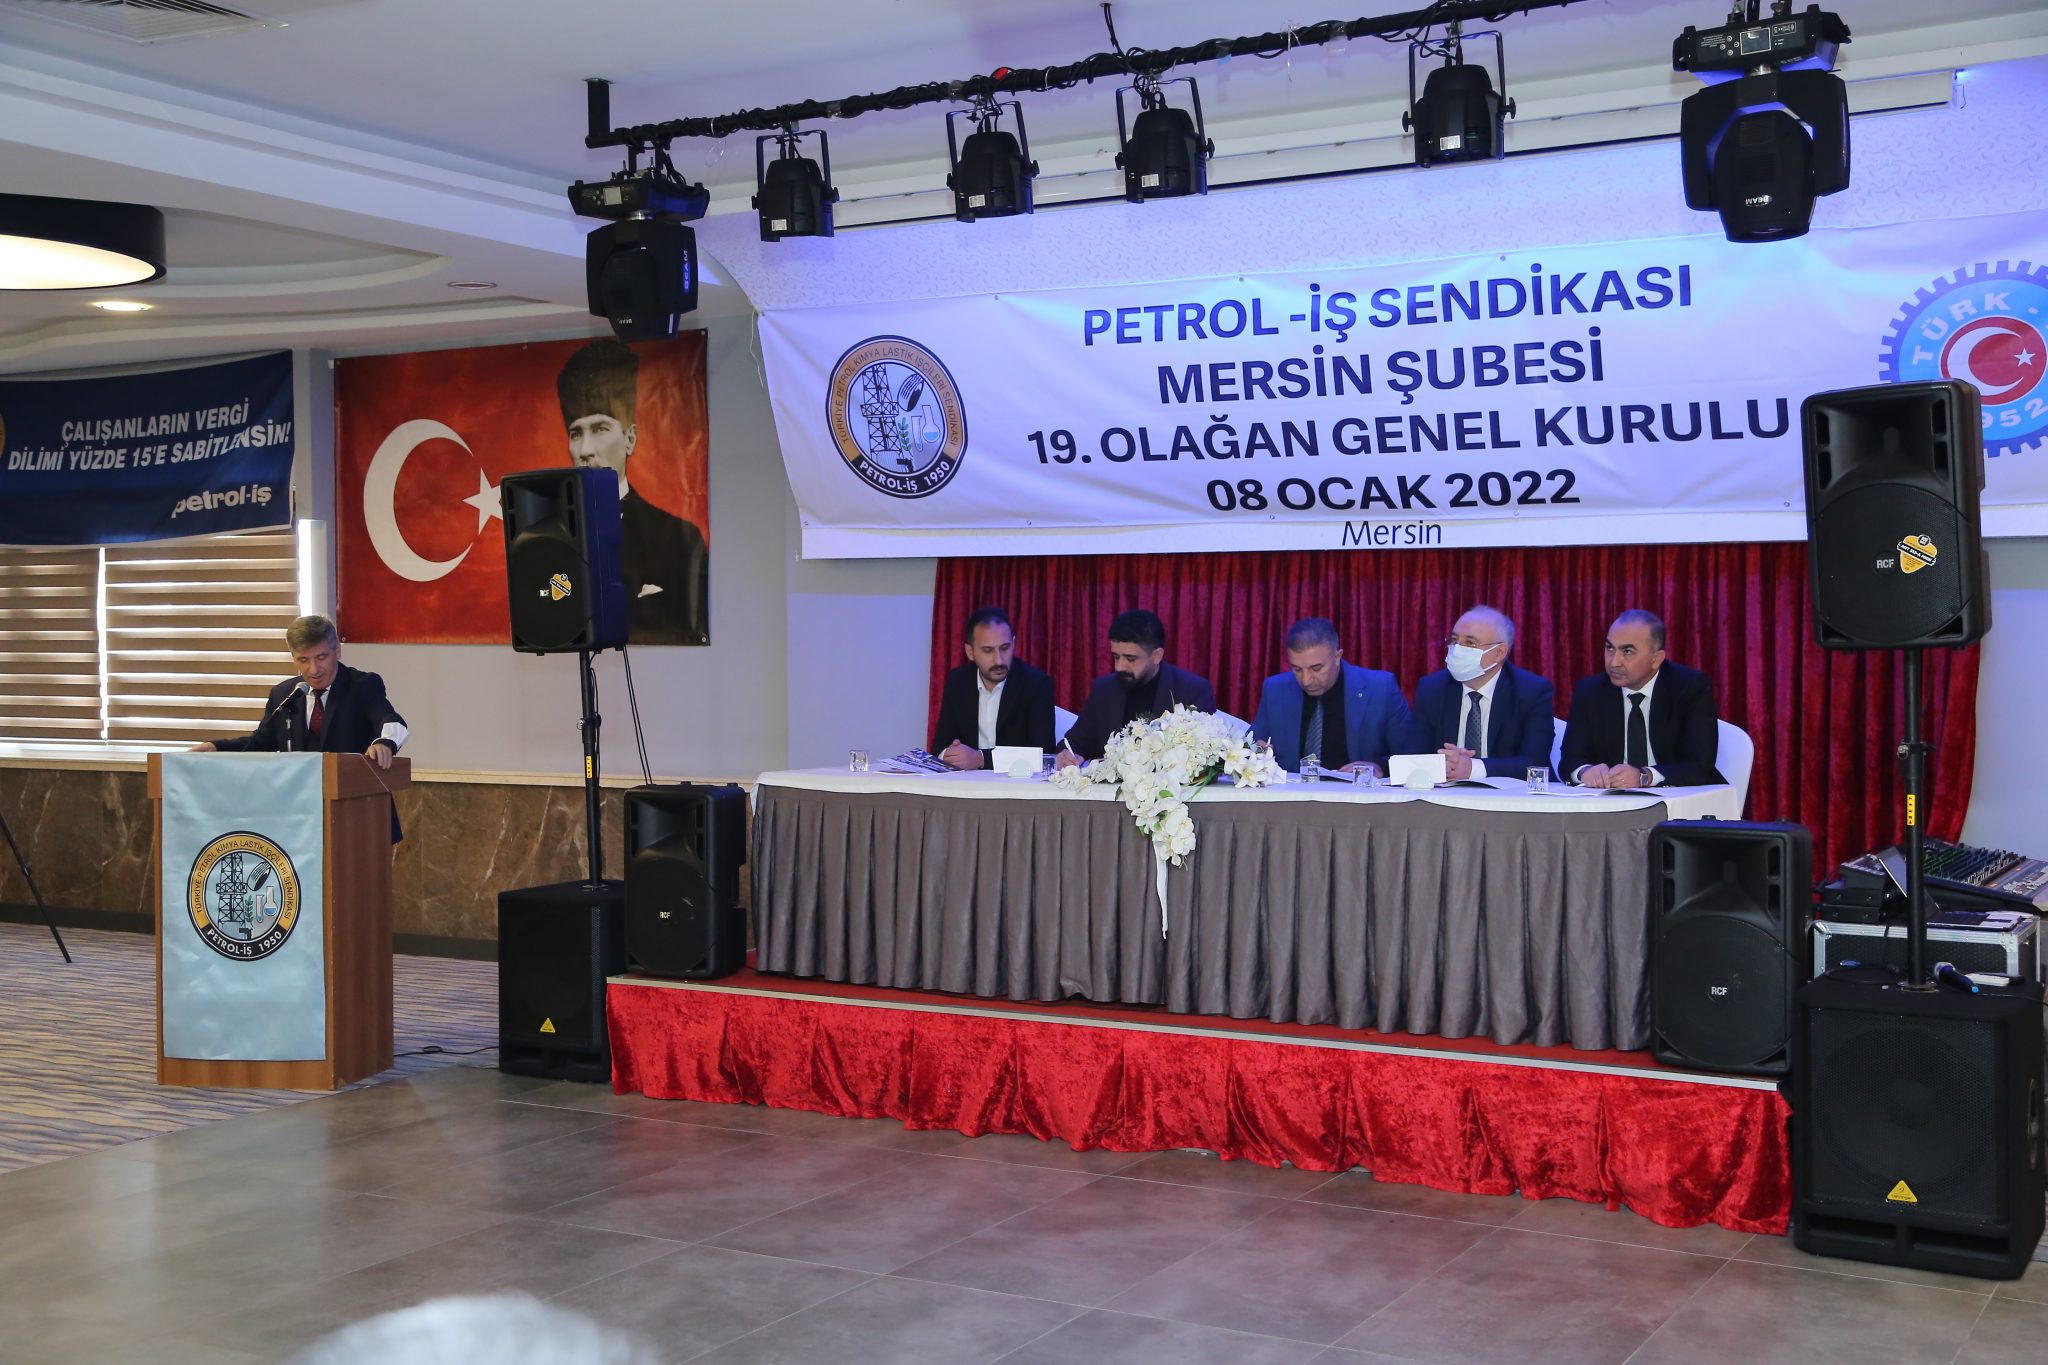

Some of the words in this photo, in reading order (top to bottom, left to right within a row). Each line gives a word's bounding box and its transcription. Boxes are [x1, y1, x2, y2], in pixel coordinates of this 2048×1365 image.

[1084, 298, 1279, 346] PETROL
[1368, 263, 1691, 328] SENDİKASI
[854, 348, 881, 367] KİMYA
[882, 347, 914, 361] LASTİK
[1158, 344, 1372, 404] MERSİN
[1387, 326, 1604, 405] ŞUBESİ
[837, 365, 855, 397] PETROL
[915, 356, 946, 391] İŞÇİLERİ
[62, 412, 189, 446] ÇALIŞANLARIN
[195, 397, 249, 431] VERGİ
[834, 400, 849, 443] TÜRKİYE
[943, 391, 959, 446] SENDİKASI
[1027, 429, 1091, 464] 19.
[1100, 414, 1319, 463] OLAĞAN
[1332, 410, 1520, 456] GENEL
[1534, 397, 1790, 447] KURULU
[8, 446, 65, 470] DİLİMİ
[69, 446, 126, 470] YÜZDE
[132, 446, 166, 467] 15'E
[859, 461, 918, 492] PETROL-İŞ
[924, 461, 950, 487] 1950
[1206, 479, 1268, 511] 08
[1276, 474, 1437, 510] OCAK
[1444, 468, 1580, 508] 2022
[171, 484, 272, 519] petrol-iş
[1342, 520, 1441, 546] Mersin
[1877, 559, 1894, 569] RCF
[216, 840, 239, 853] KİMYA
[240, 840, 265, 851] LASTİK
[198, 852, 217, 878] PETROL
[264, 848, 289, 876] İŞÇİLERİ
[194, 880, 203, 913] TÜRKİYE
[283, 876, 296, 920] SENDİKASI
[207, 928, 252, 956] PETROL-İŞ
[258, 931, 282, 952] 1950
[1711, 986, 1727, 995] RCF
